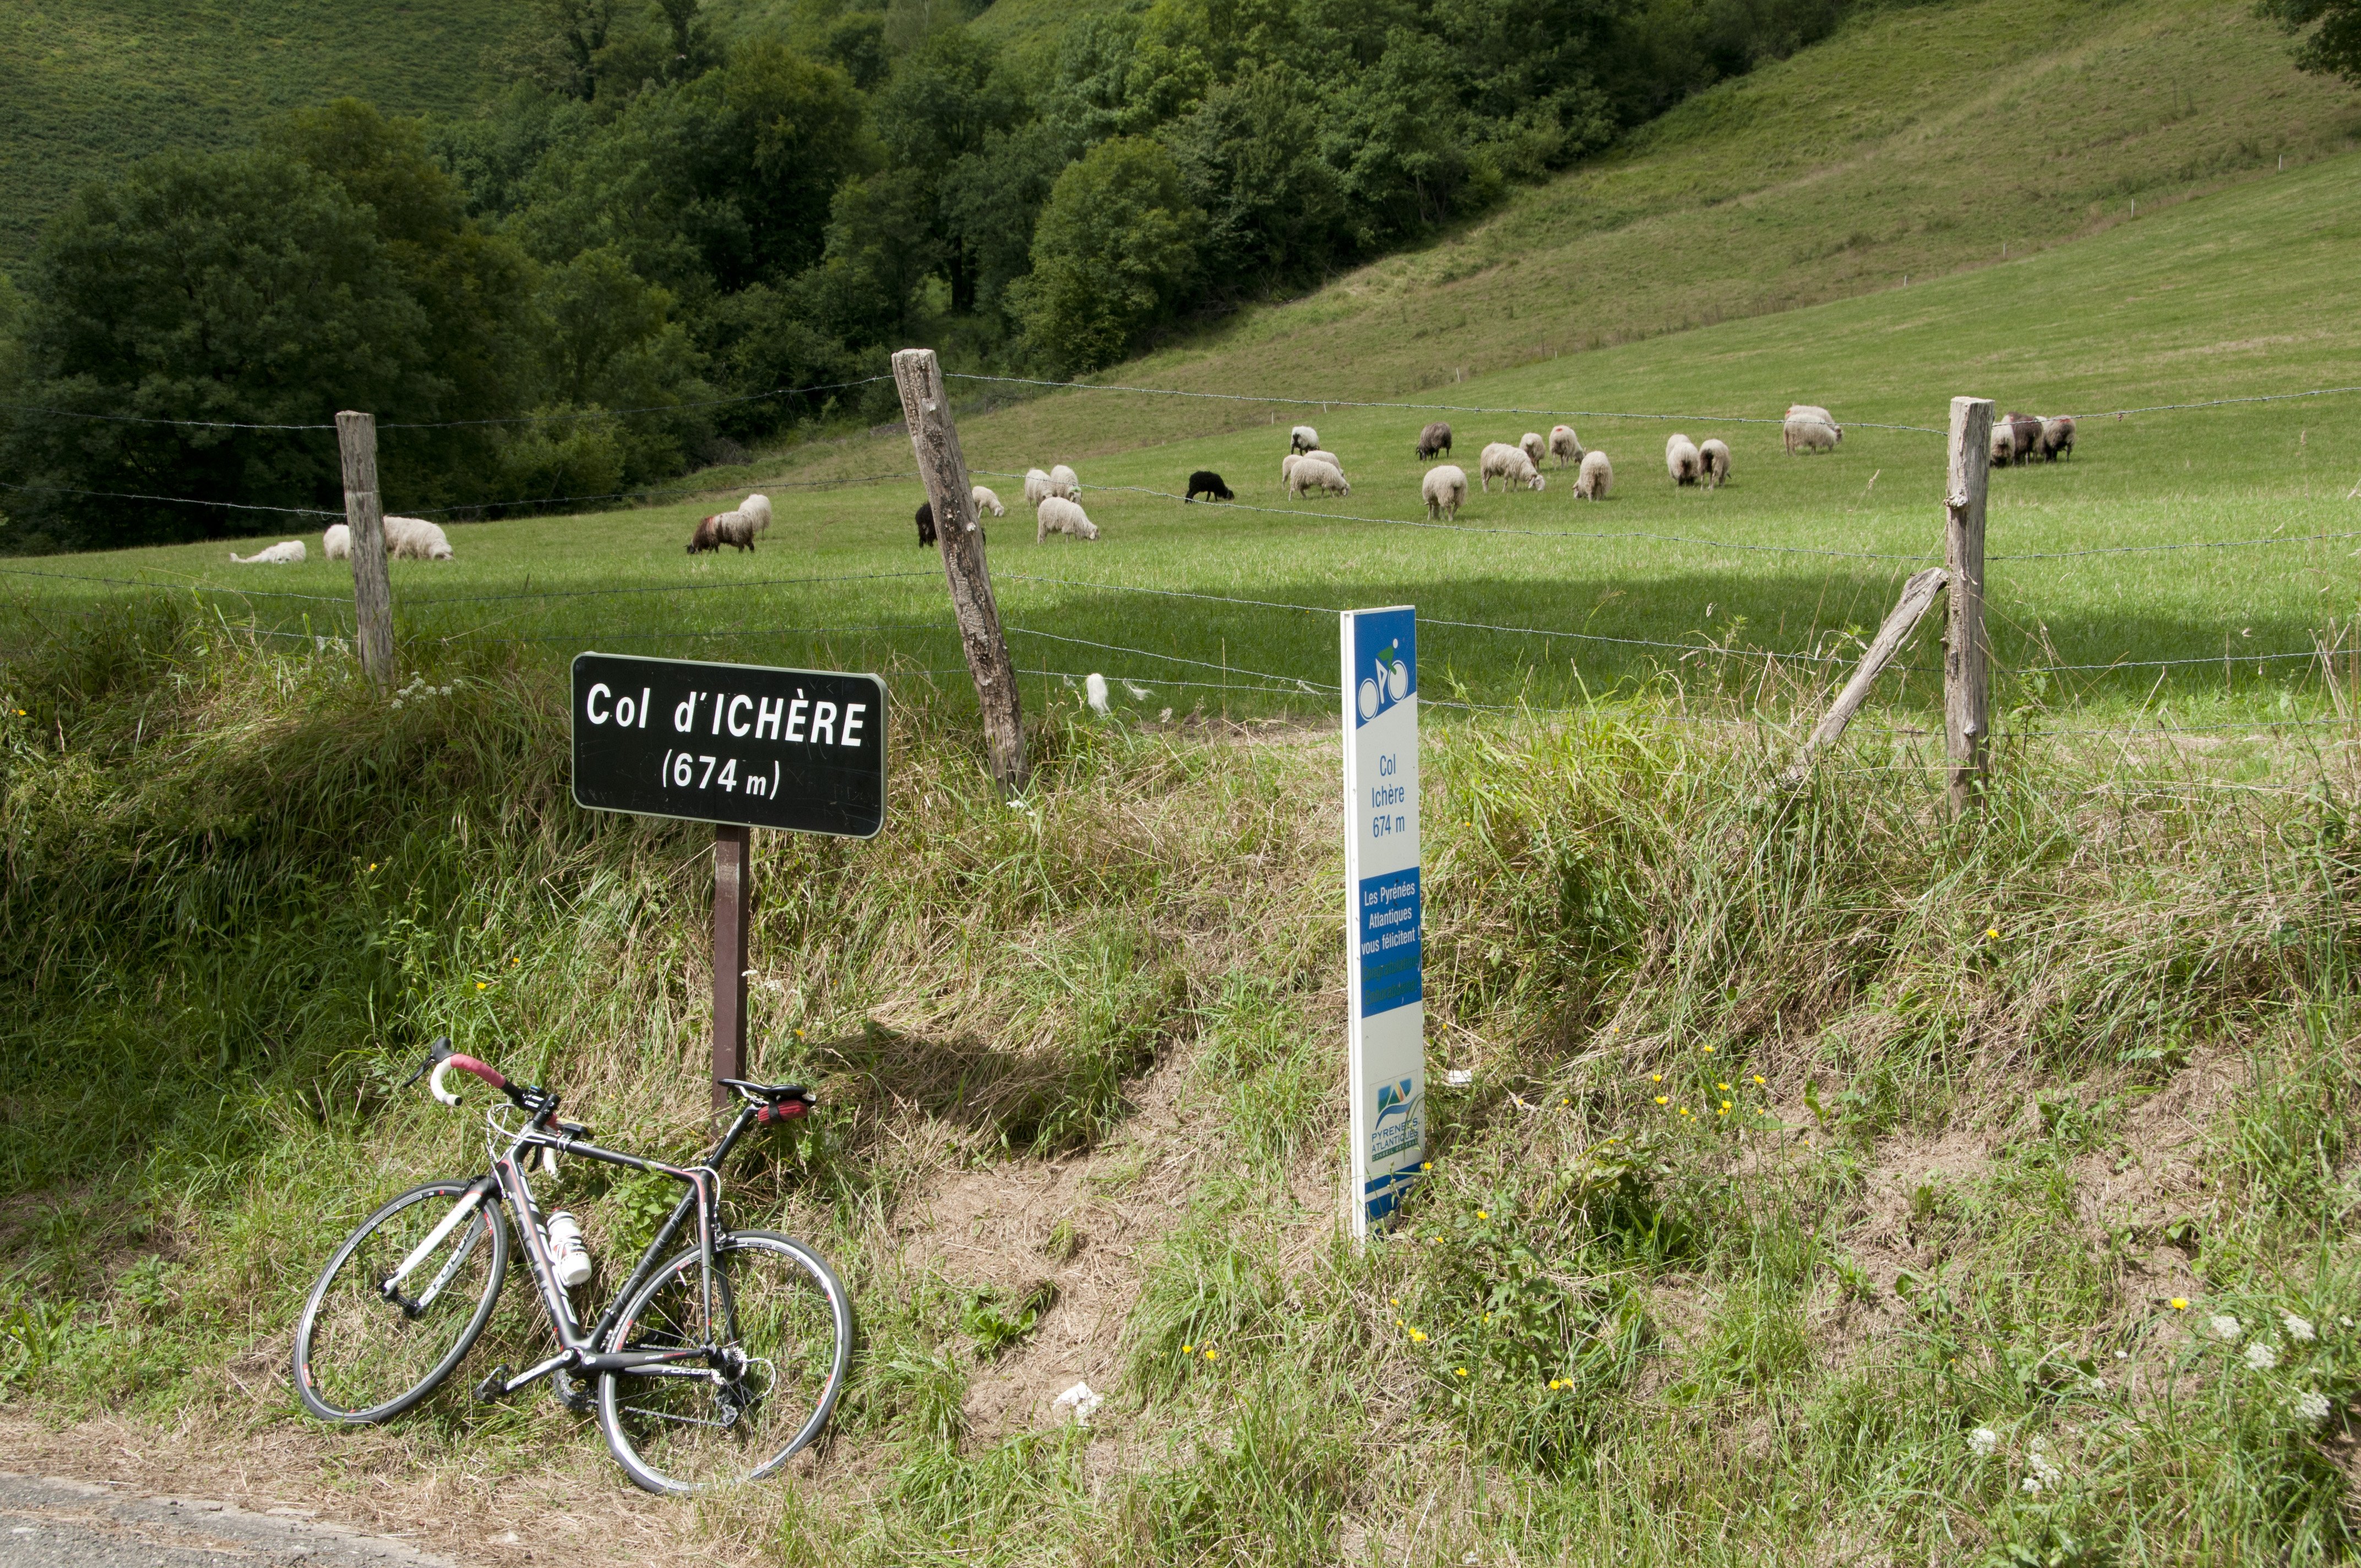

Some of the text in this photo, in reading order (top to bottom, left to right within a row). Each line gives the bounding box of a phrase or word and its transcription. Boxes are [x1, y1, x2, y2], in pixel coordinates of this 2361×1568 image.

[587, 683, 866, 747] Col d'ICHÈRE
[662, 749, 780, 800] (674 m)
[1380, 754, 1396, 777] Col
[1372, 783, 1405, 808] Ichère
[1373, 815, 1405, 838] 674 m
[1364, 881, 1415, 906] Les Pyrénées
[1369, 907, 1412, 929] Atlantiques
[1361, 941, 1379, 955] vous
[1382, 927, 1415, 950] félicitent
[1372, 1130, 1418, 1153] ATLANTIQUES
[1372, 1150, 1394, 1161] CONSEIL
